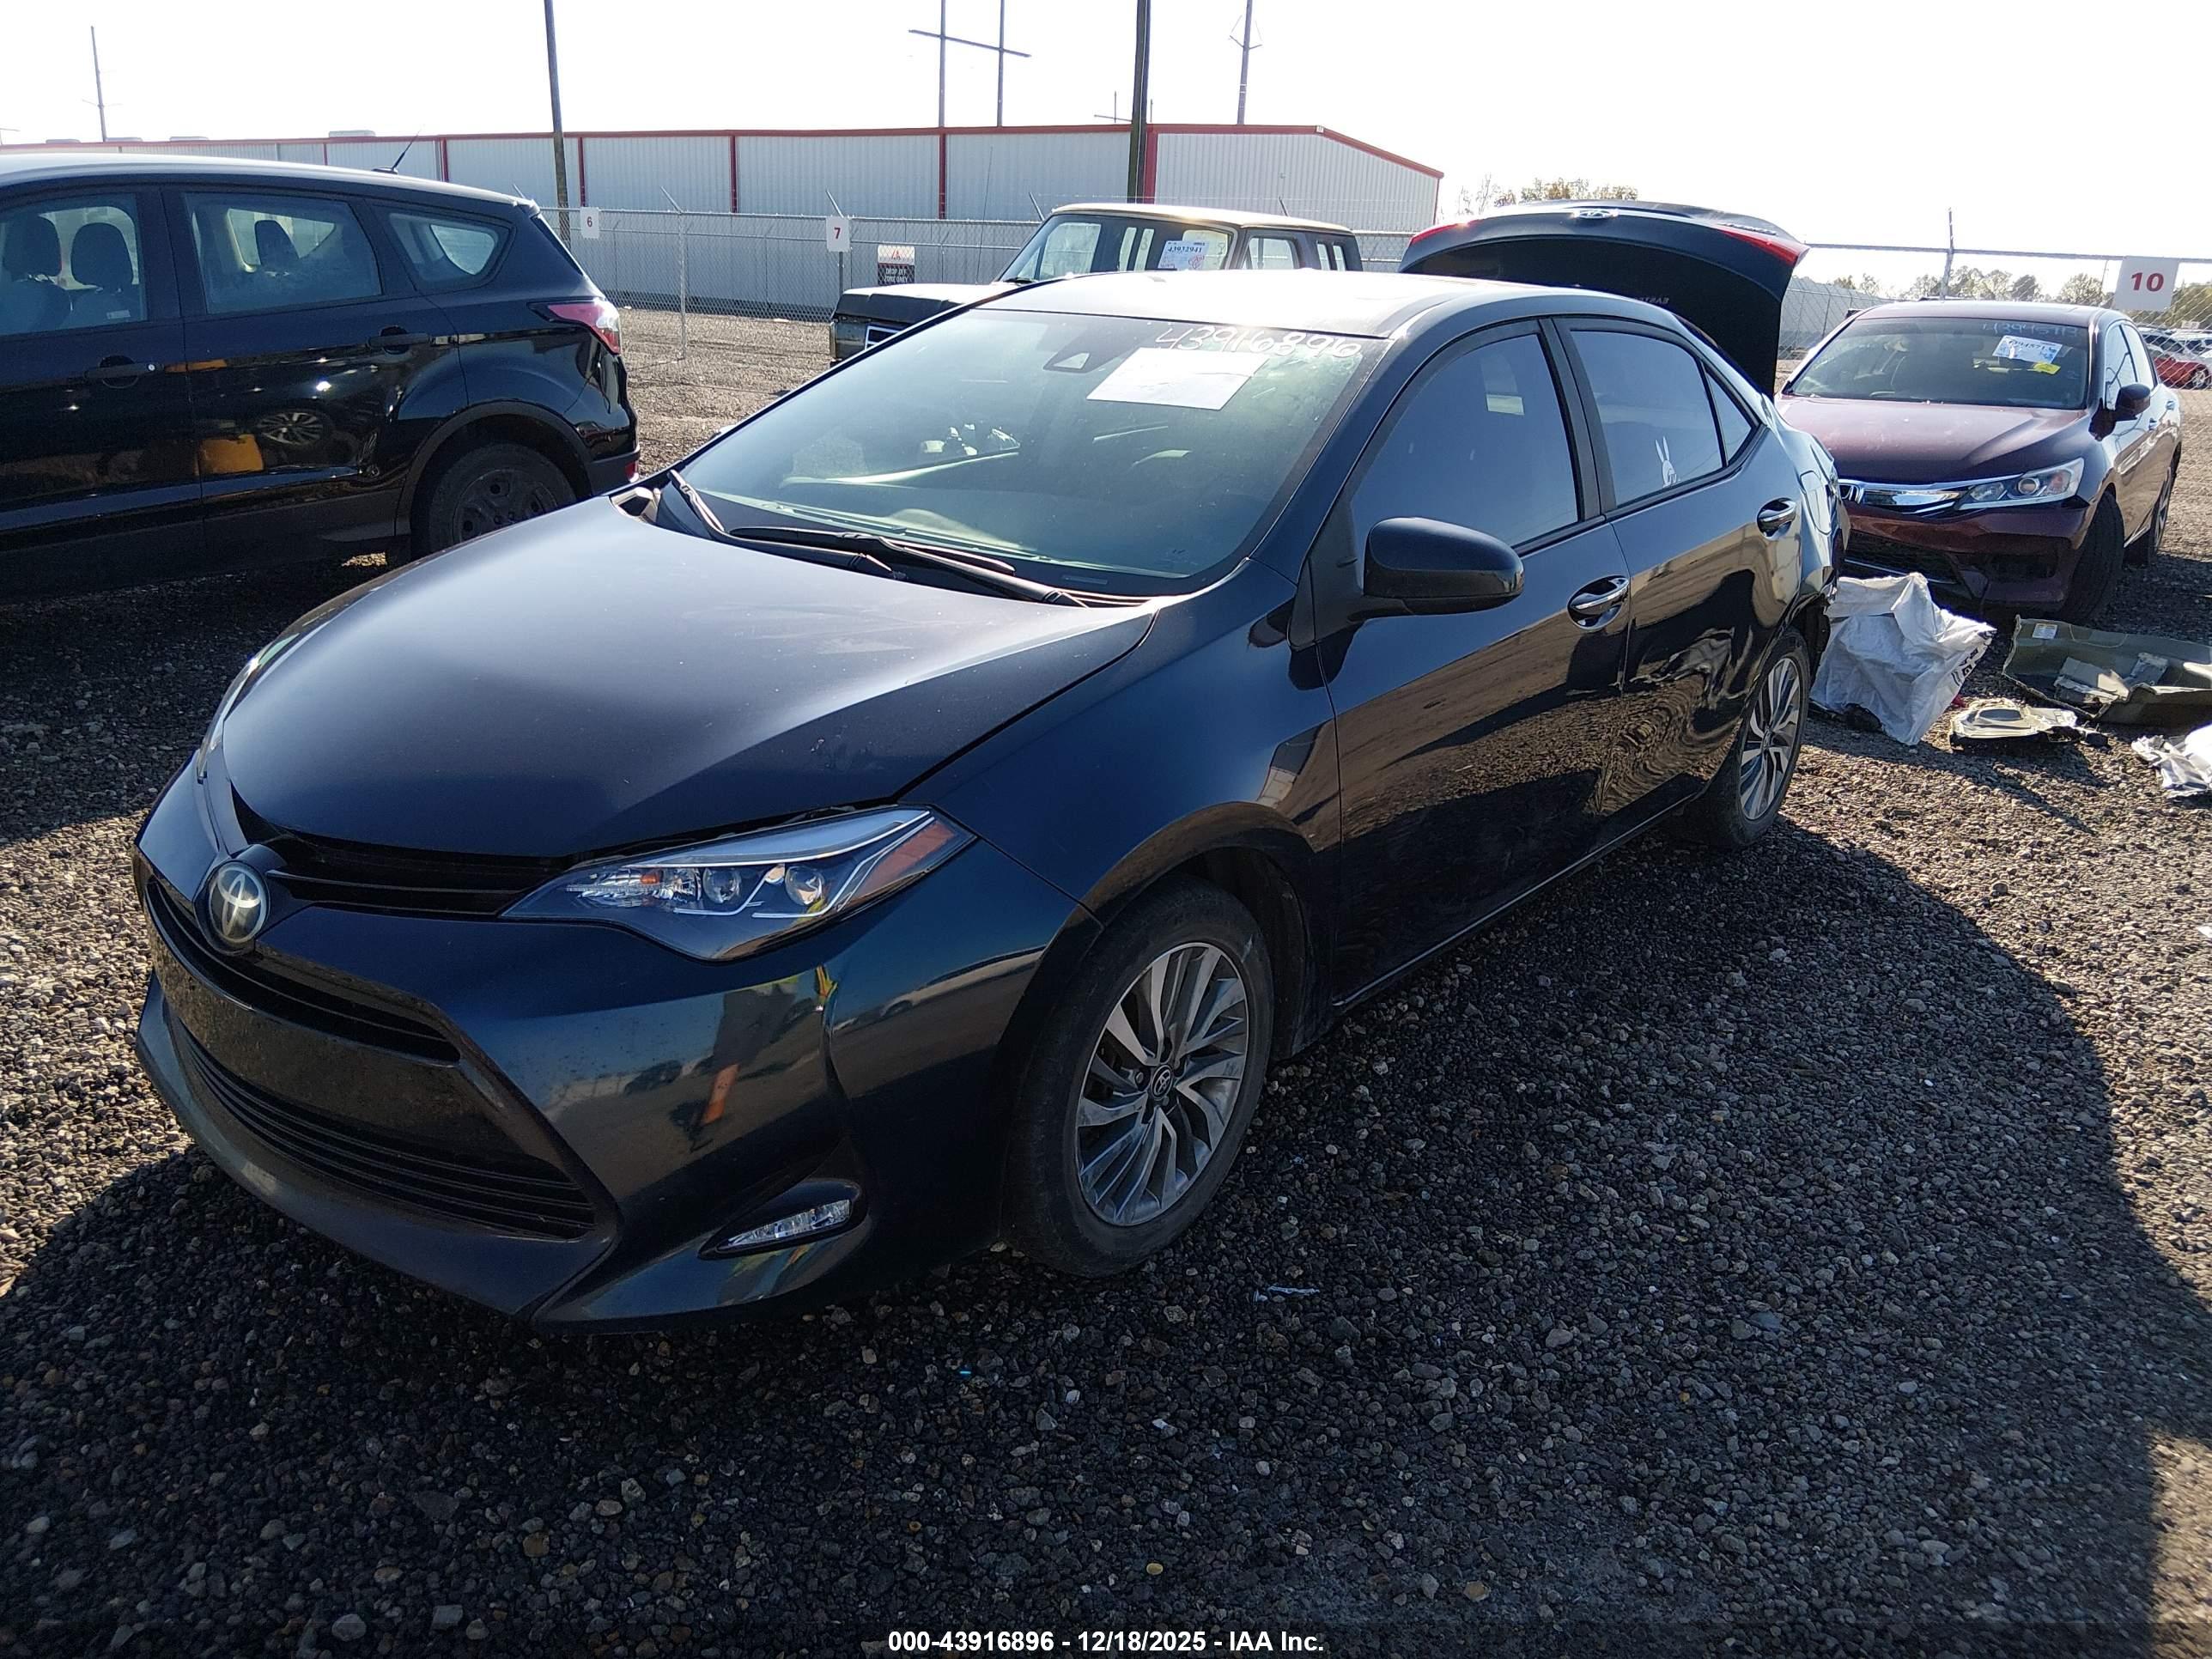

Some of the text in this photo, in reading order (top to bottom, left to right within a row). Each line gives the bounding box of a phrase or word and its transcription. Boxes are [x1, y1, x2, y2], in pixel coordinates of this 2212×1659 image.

[586, 216, 593, 228] 6
[834, 227, 842, 240] 7
[2131, 272, 2165, 292] 10
[1155, 325, 1362, 358] 43916896
